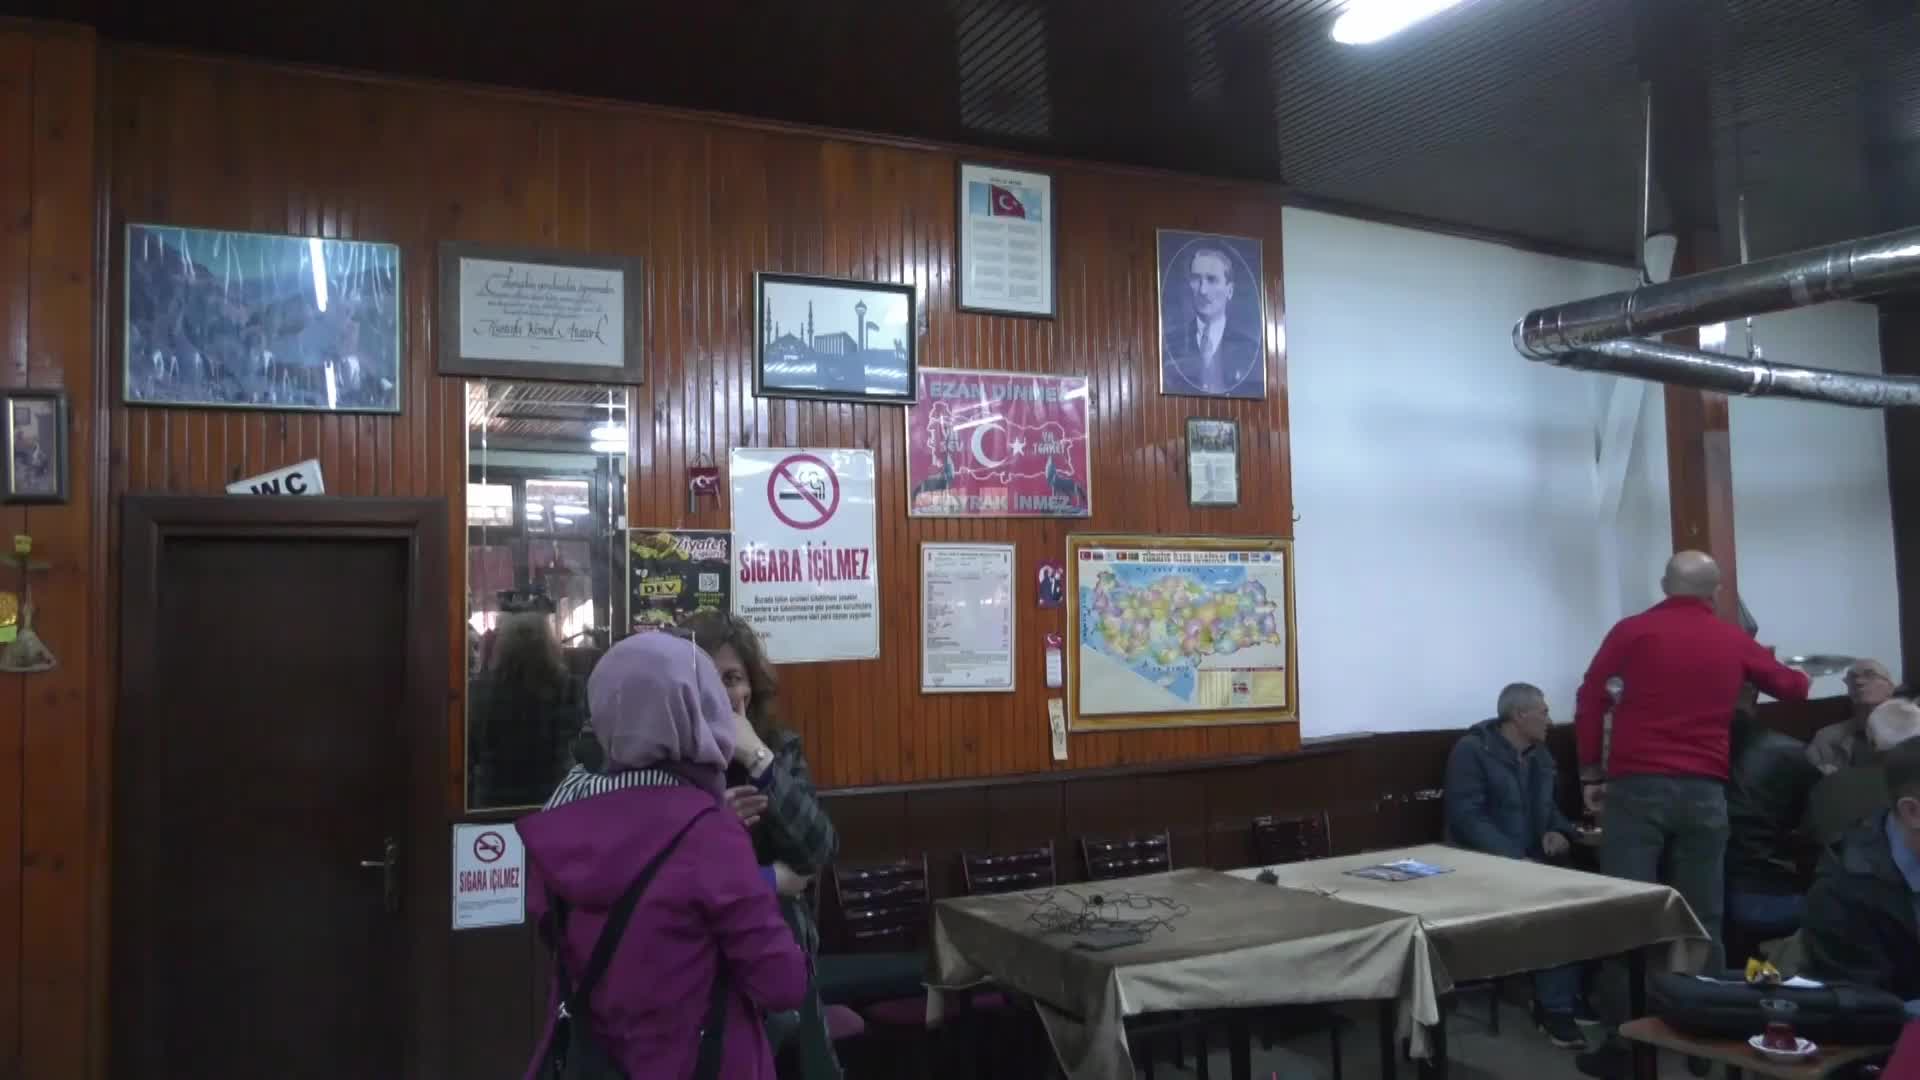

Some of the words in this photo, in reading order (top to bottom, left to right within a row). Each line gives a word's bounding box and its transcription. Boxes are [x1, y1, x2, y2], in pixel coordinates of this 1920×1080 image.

[250, 472, 307, 495] WC
[740, 541, 802, 583] SİGARA
[807, 541, 871, 586] İÇİLMEZ
[459, 869, 488, 893] SİGARA
[490, 867, 520, 894] İÇİLMEZ
